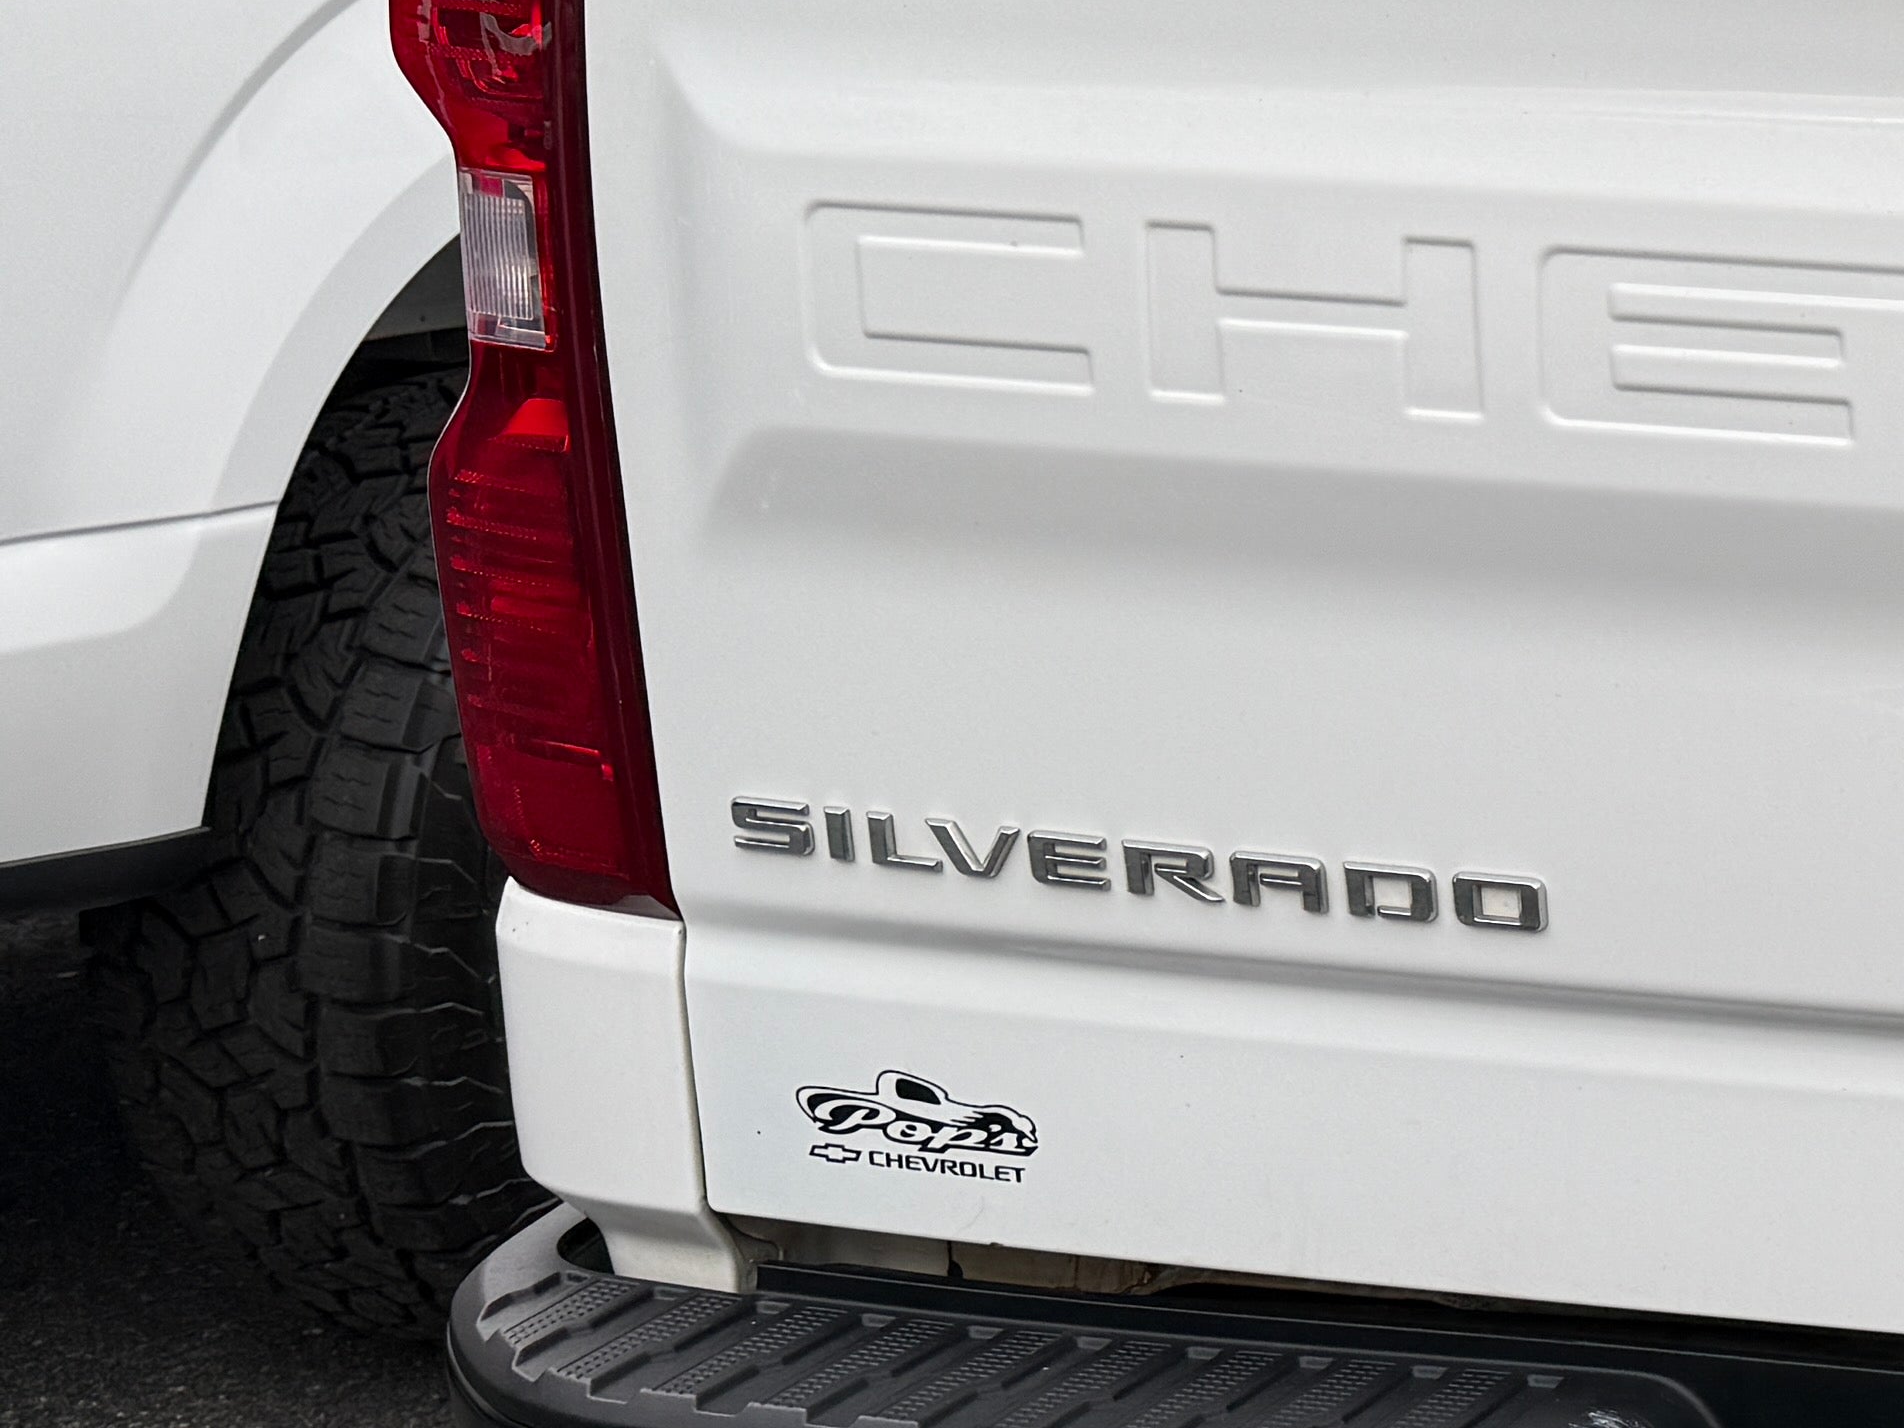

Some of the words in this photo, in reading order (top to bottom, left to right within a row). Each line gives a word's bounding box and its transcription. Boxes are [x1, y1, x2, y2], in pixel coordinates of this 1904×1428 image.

[730, 795, 1550, 932] SILVERADO
[813, 1098, 1026, 1152] Pop's
[868, 1149, 1026, 1184] CHEVROLET
